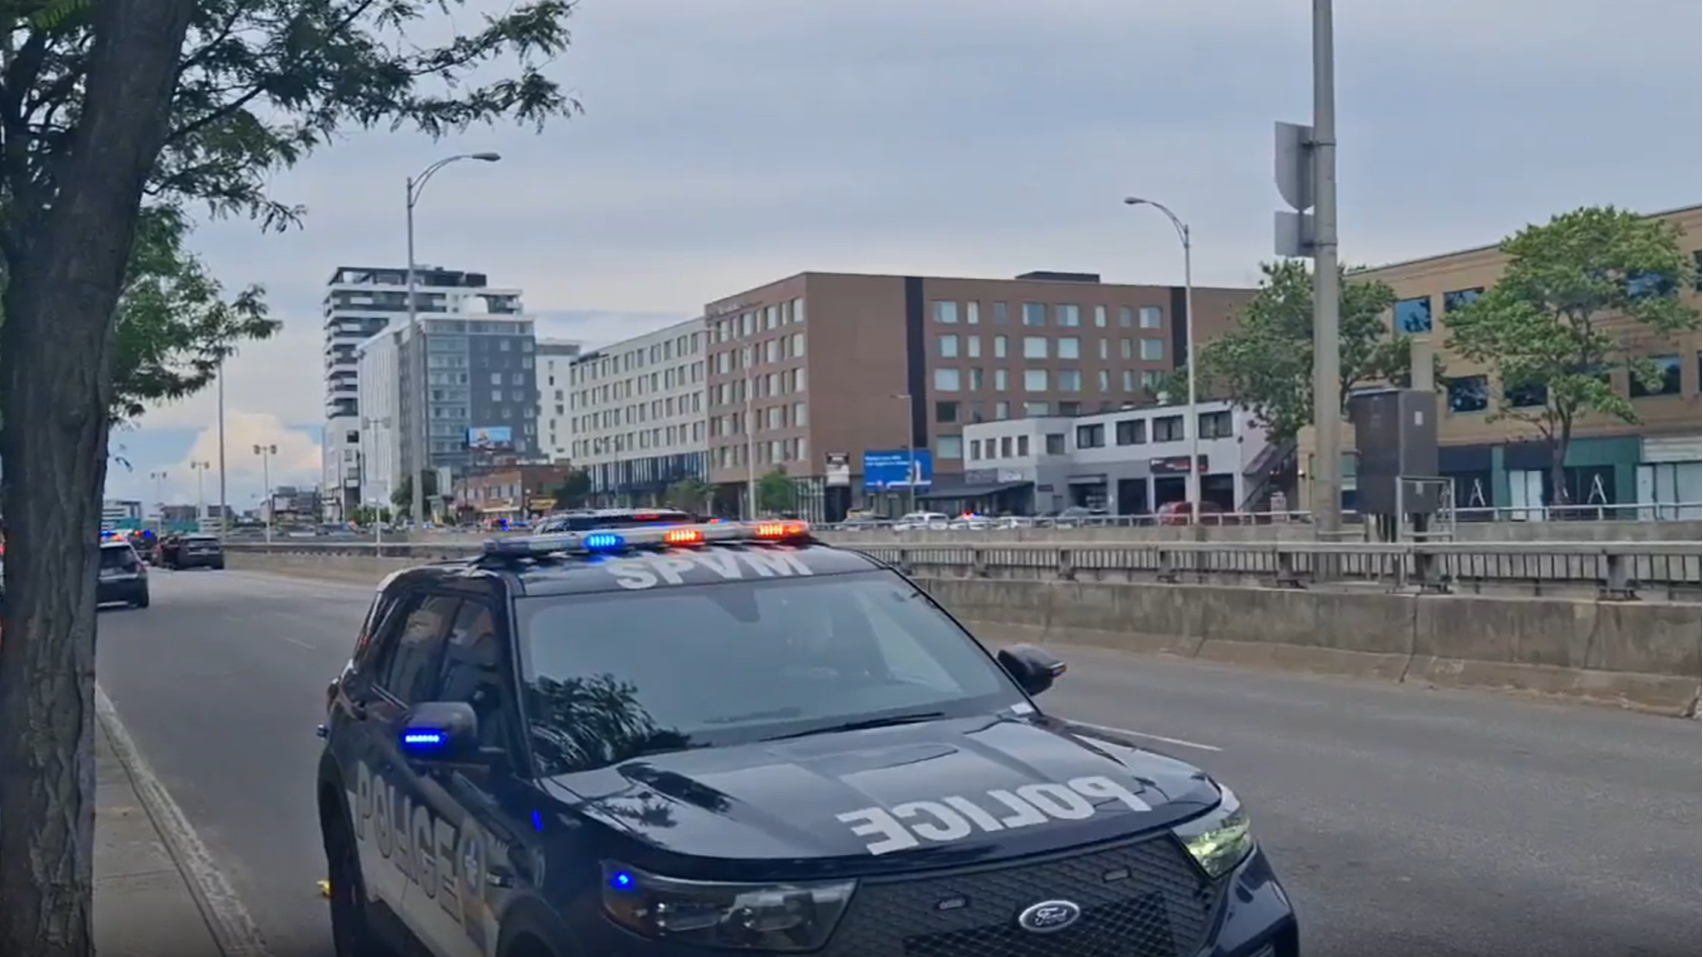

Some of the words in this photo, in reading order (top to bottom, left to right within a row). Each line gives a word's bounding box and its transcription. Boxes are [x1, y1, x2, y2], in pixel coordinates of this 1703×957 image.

[606, 545, 813, 590] SPVM
[357, 760, 463, 924] POLICE
[1034, 906, 1067, 926] Ford
